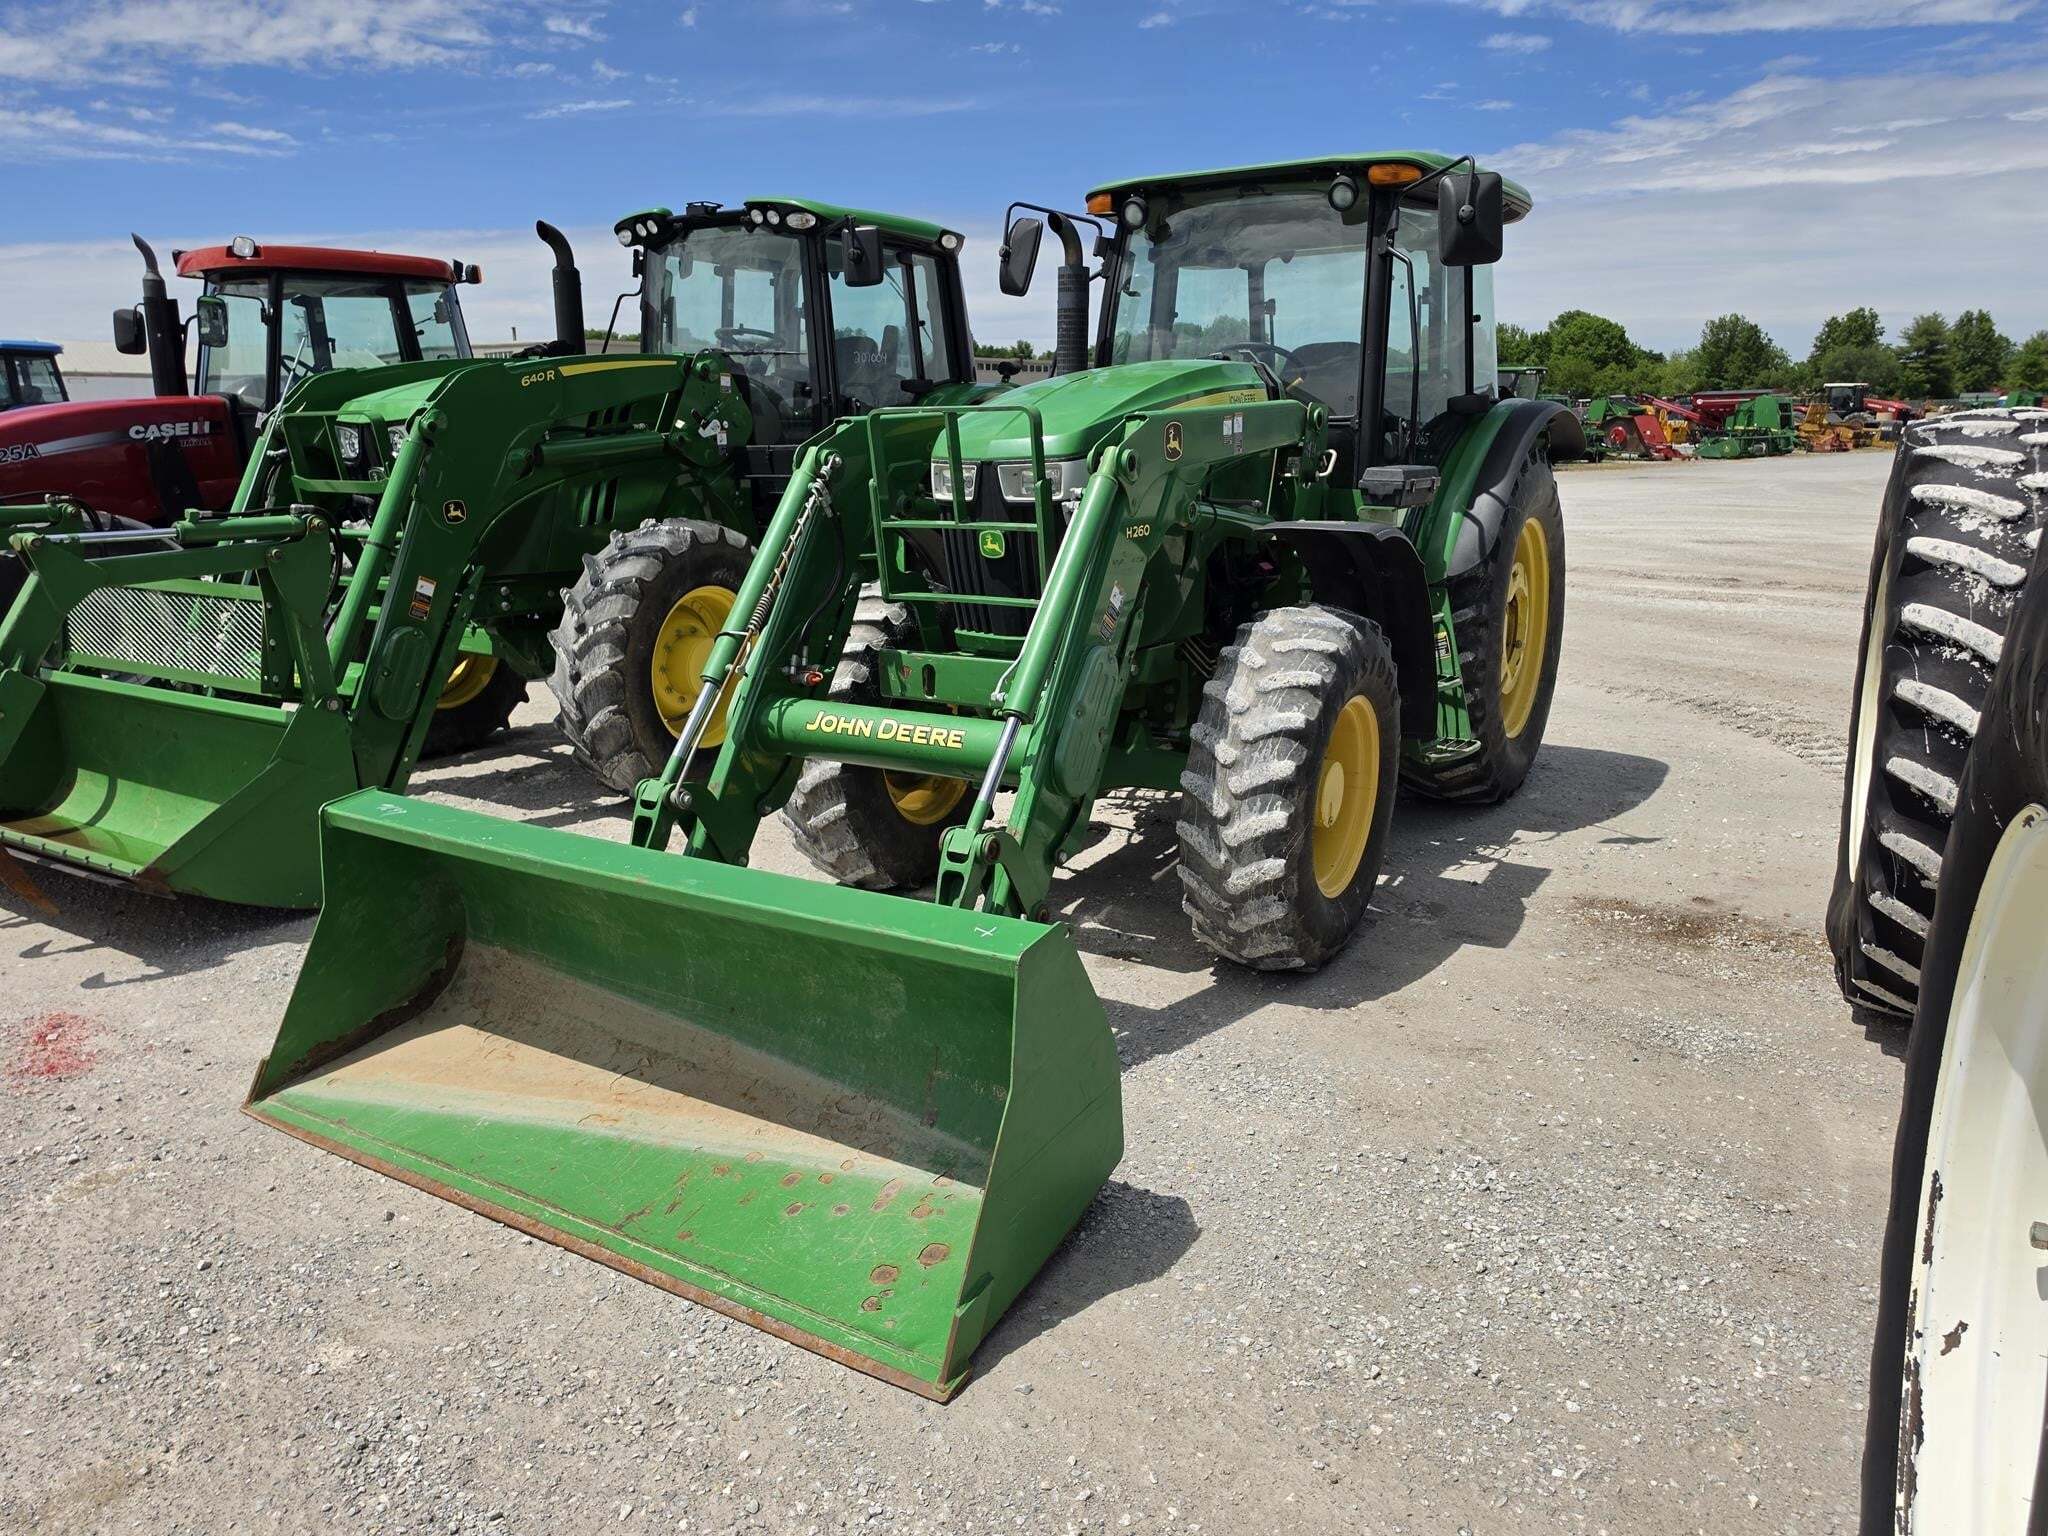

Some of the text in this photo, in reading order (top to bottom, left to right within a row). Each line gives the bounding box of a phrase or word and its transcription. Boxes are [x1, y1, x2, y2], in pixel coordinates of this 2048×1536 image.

[128, 422, 190, 440] CASE
[1126, 524, 1151, 539] H260
[805, 710, 967, 750] JOHN DEERE
